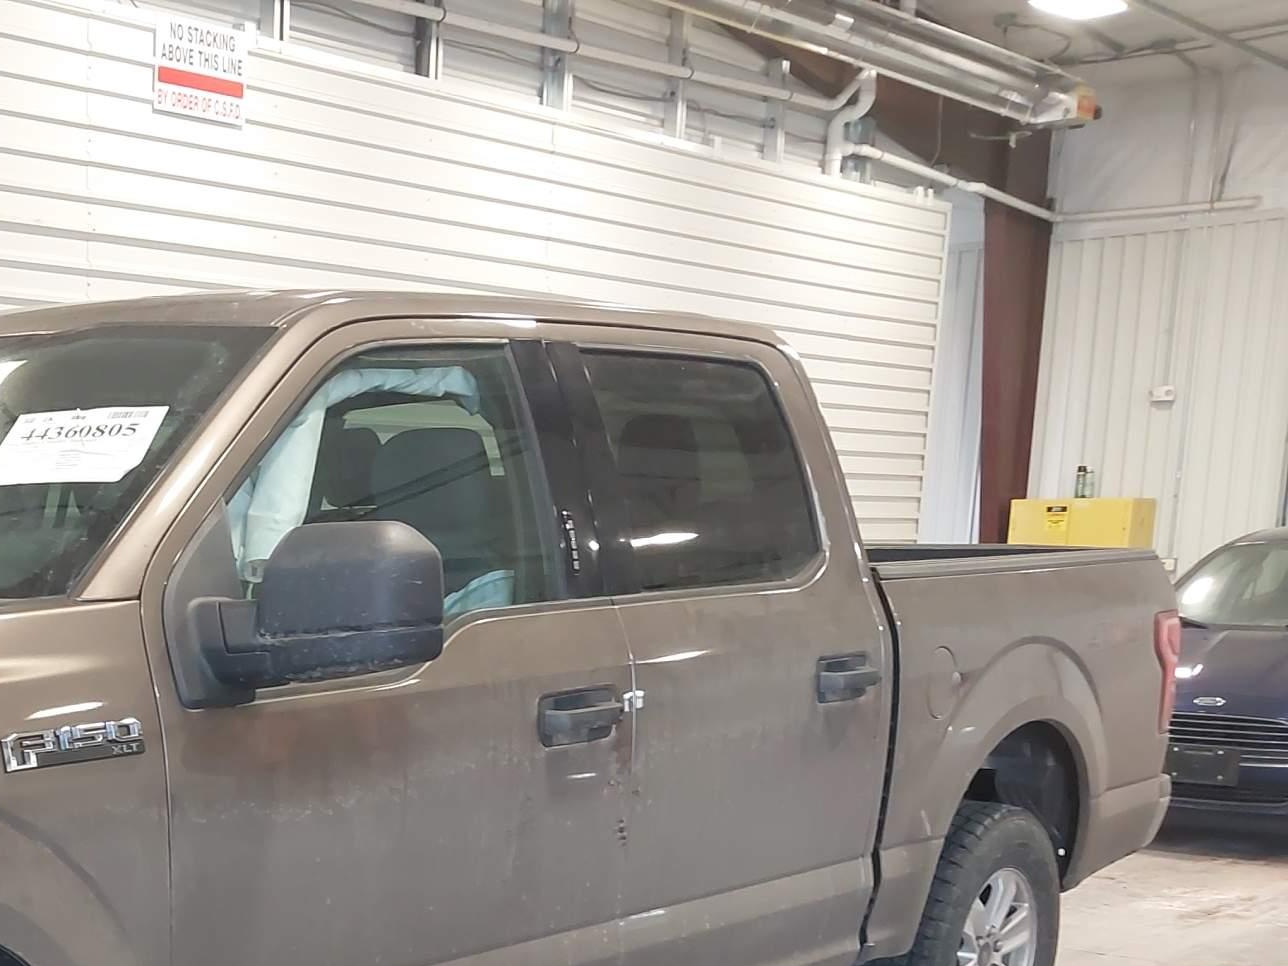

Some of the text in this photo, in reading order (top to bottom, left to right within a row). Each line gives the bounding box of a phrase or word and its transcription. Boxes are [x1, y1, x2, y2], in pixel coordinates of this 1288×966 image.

[170, 22, 236, 52] NO STACKING
[161, 43, 243, 76] ABOVE THIS LINE
[158, 89, 168, 105] BY
[171, 91, 199, 111] ORDER
[202, 97, 212, 113] OF
[20, 423, 140, 441] 44360805
[112, 743, 140, 755] XLT
